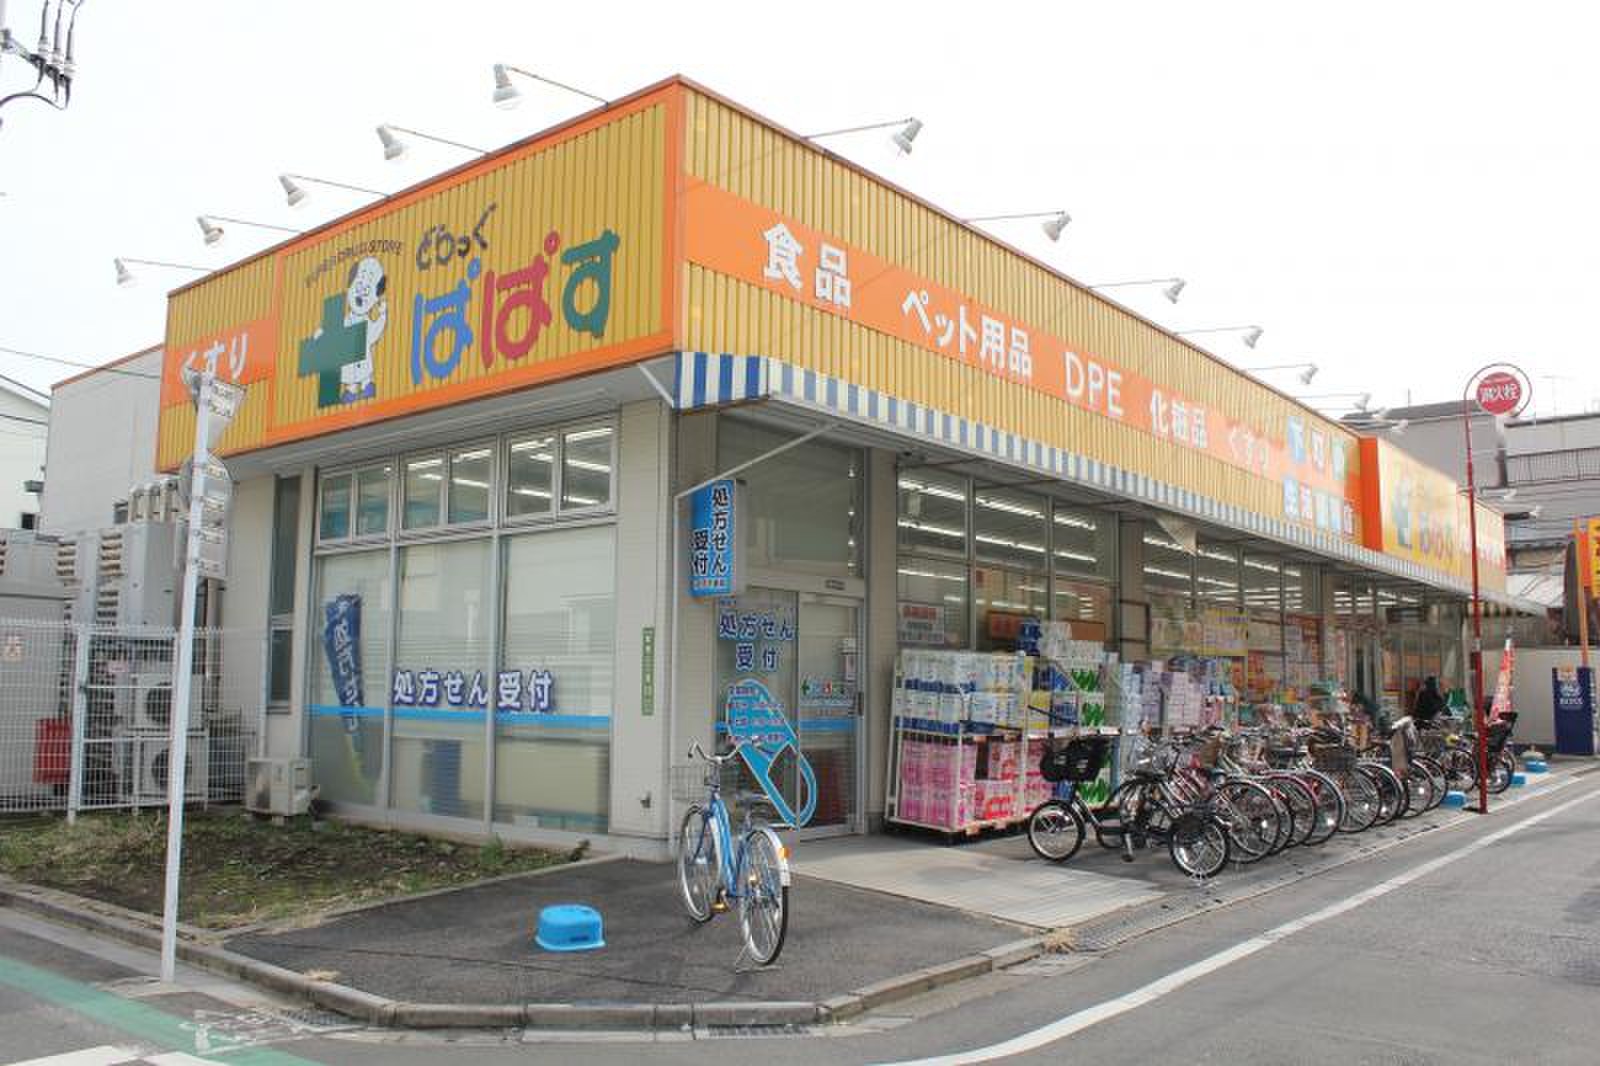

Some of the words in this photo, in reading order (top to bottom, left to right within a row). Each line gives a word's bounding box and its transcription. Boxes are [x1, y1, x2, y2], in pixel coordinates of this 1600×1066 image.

[762, 223, 851, 308] 食品
[411, 229, 620, 385] ぱぱす
[901, 289, 1034, 379] ペット用品
[1065, 354, 1124, 418] DPE
[1151, 390, 1207, 450] 化粧品
[691, 529, 709, 576] 受付
[711, 486, 730, 576] 処方せん
[718, 613, 795, 641] 処方せん
[736, 643, 779, 672] 受付
